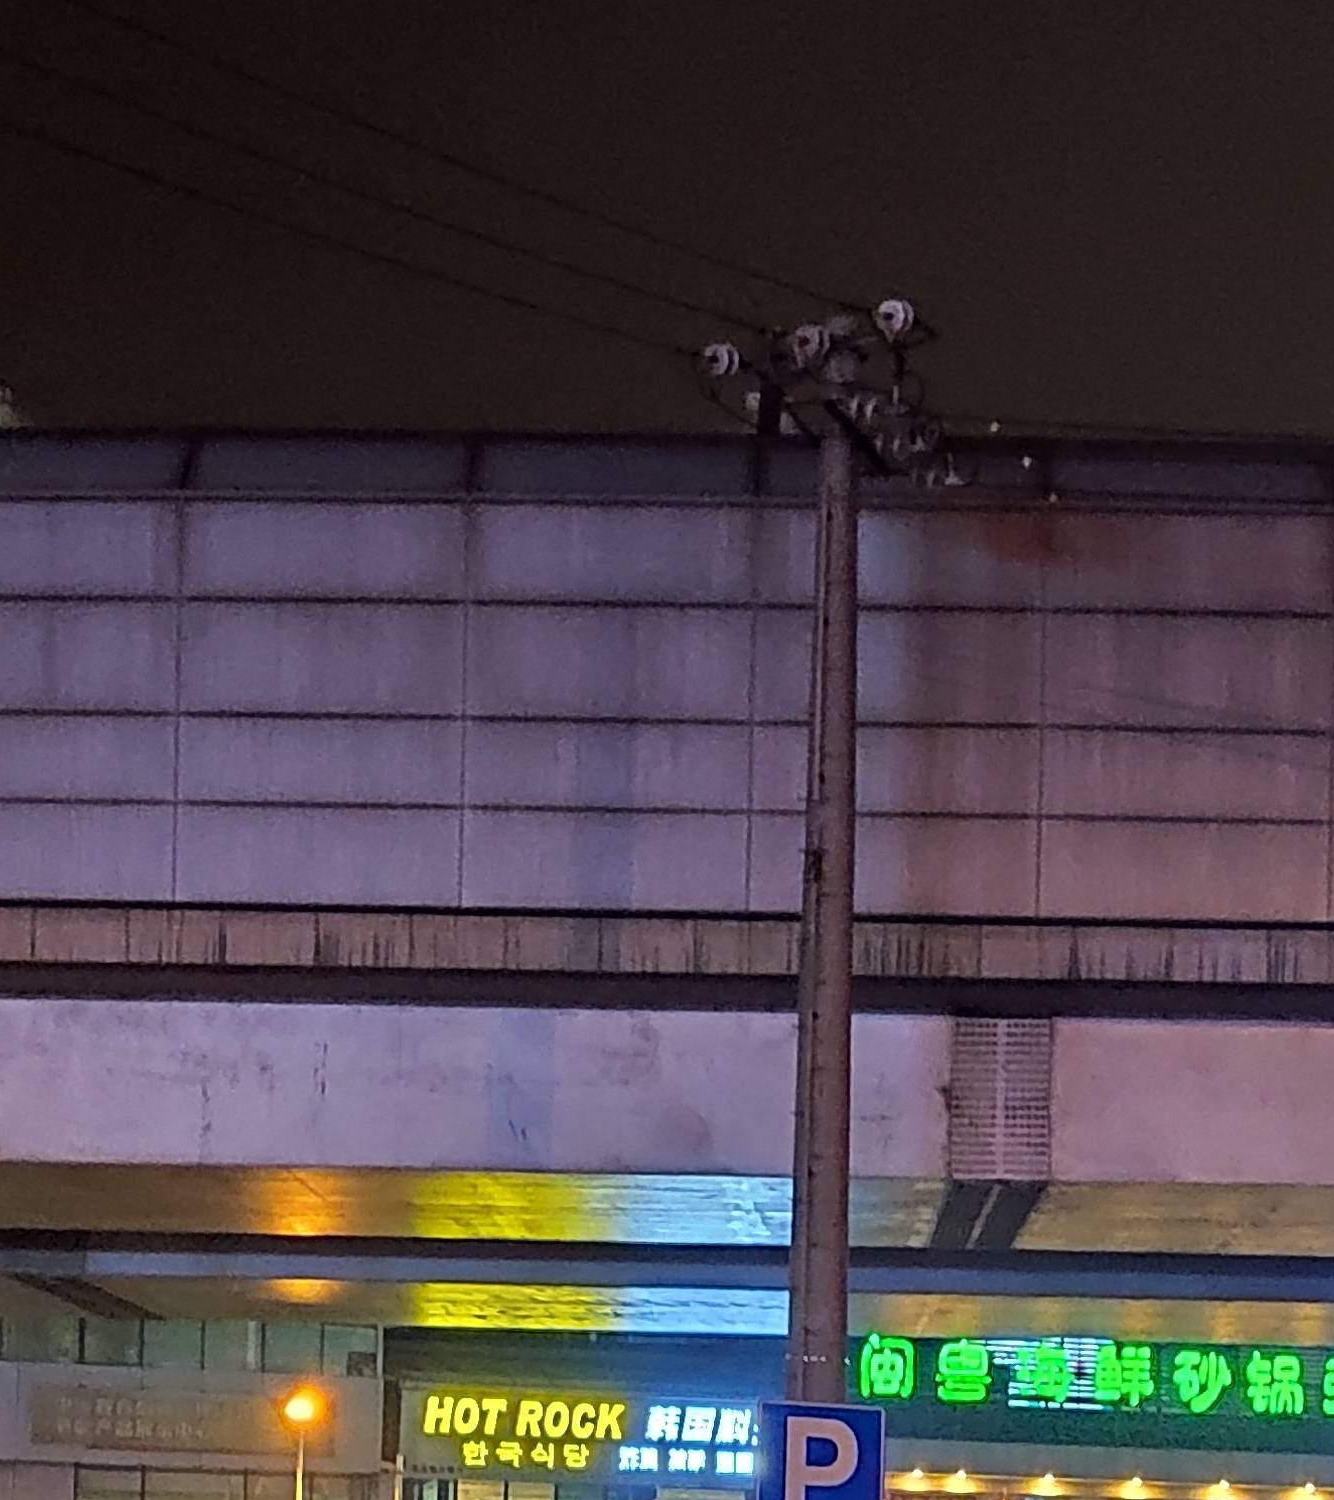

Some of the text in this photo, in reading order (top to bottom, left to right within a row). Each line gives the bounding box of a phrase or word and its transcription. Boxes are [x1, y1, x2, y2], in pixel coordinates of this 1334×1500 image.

[423, 1396, 626, 1440] HOT ROCK
[645, 1405, 759, 1446] 韩国料
[462, 1440, 590, 1469] 한국식당
